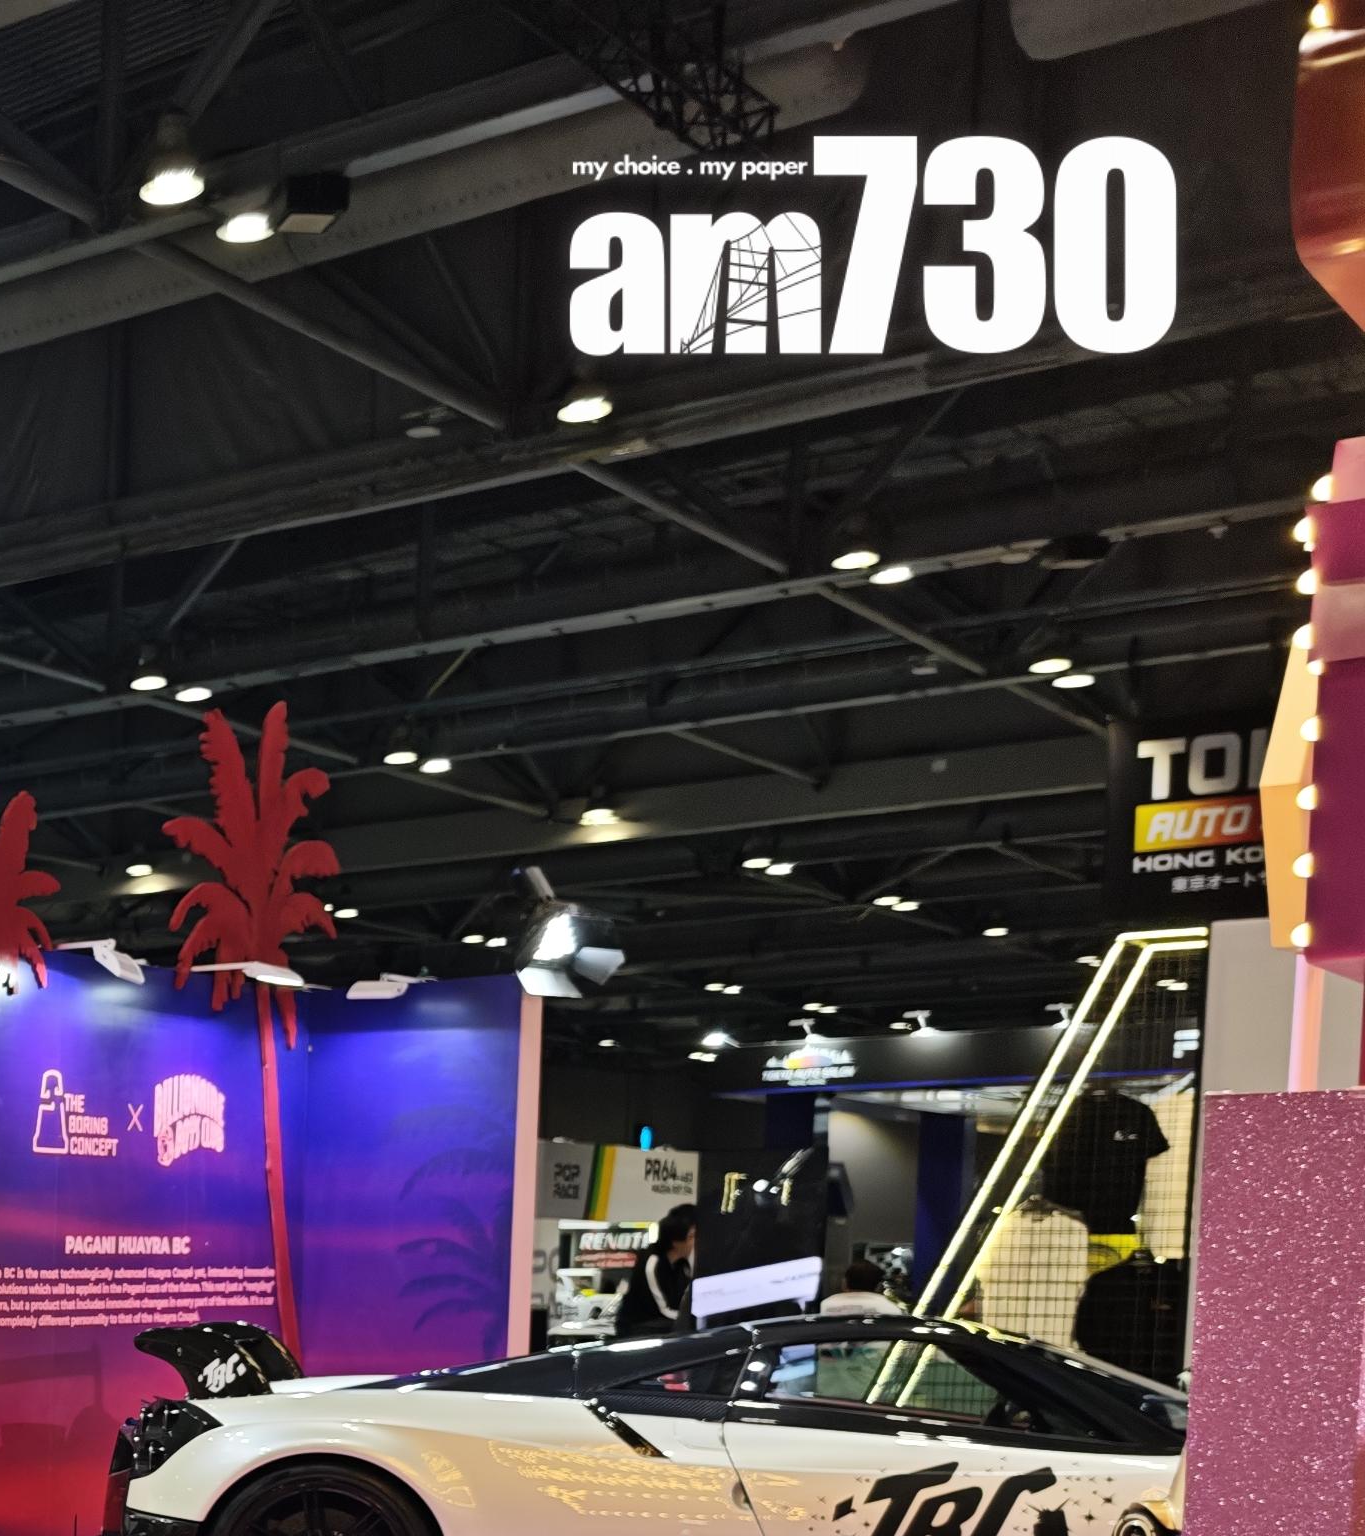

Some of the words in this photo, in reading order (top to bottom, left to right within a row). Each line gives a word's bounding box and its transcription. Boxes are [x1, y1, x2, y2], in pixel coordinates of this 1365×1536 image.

[1146, 804, 1253, 843] AUTO
[1132, 849, 1215, 874] HONG
[63, 1093, 86, 1113] THE
[68, 1115, 109, 1135] BORING
[70, 1136, 119, 1157] CONCEPT
[65, 1235, 117, 1255] PAGANI
[118, 1235, 171, 1255] HUAYRA
[172, 1235, 191, 1255] BC
